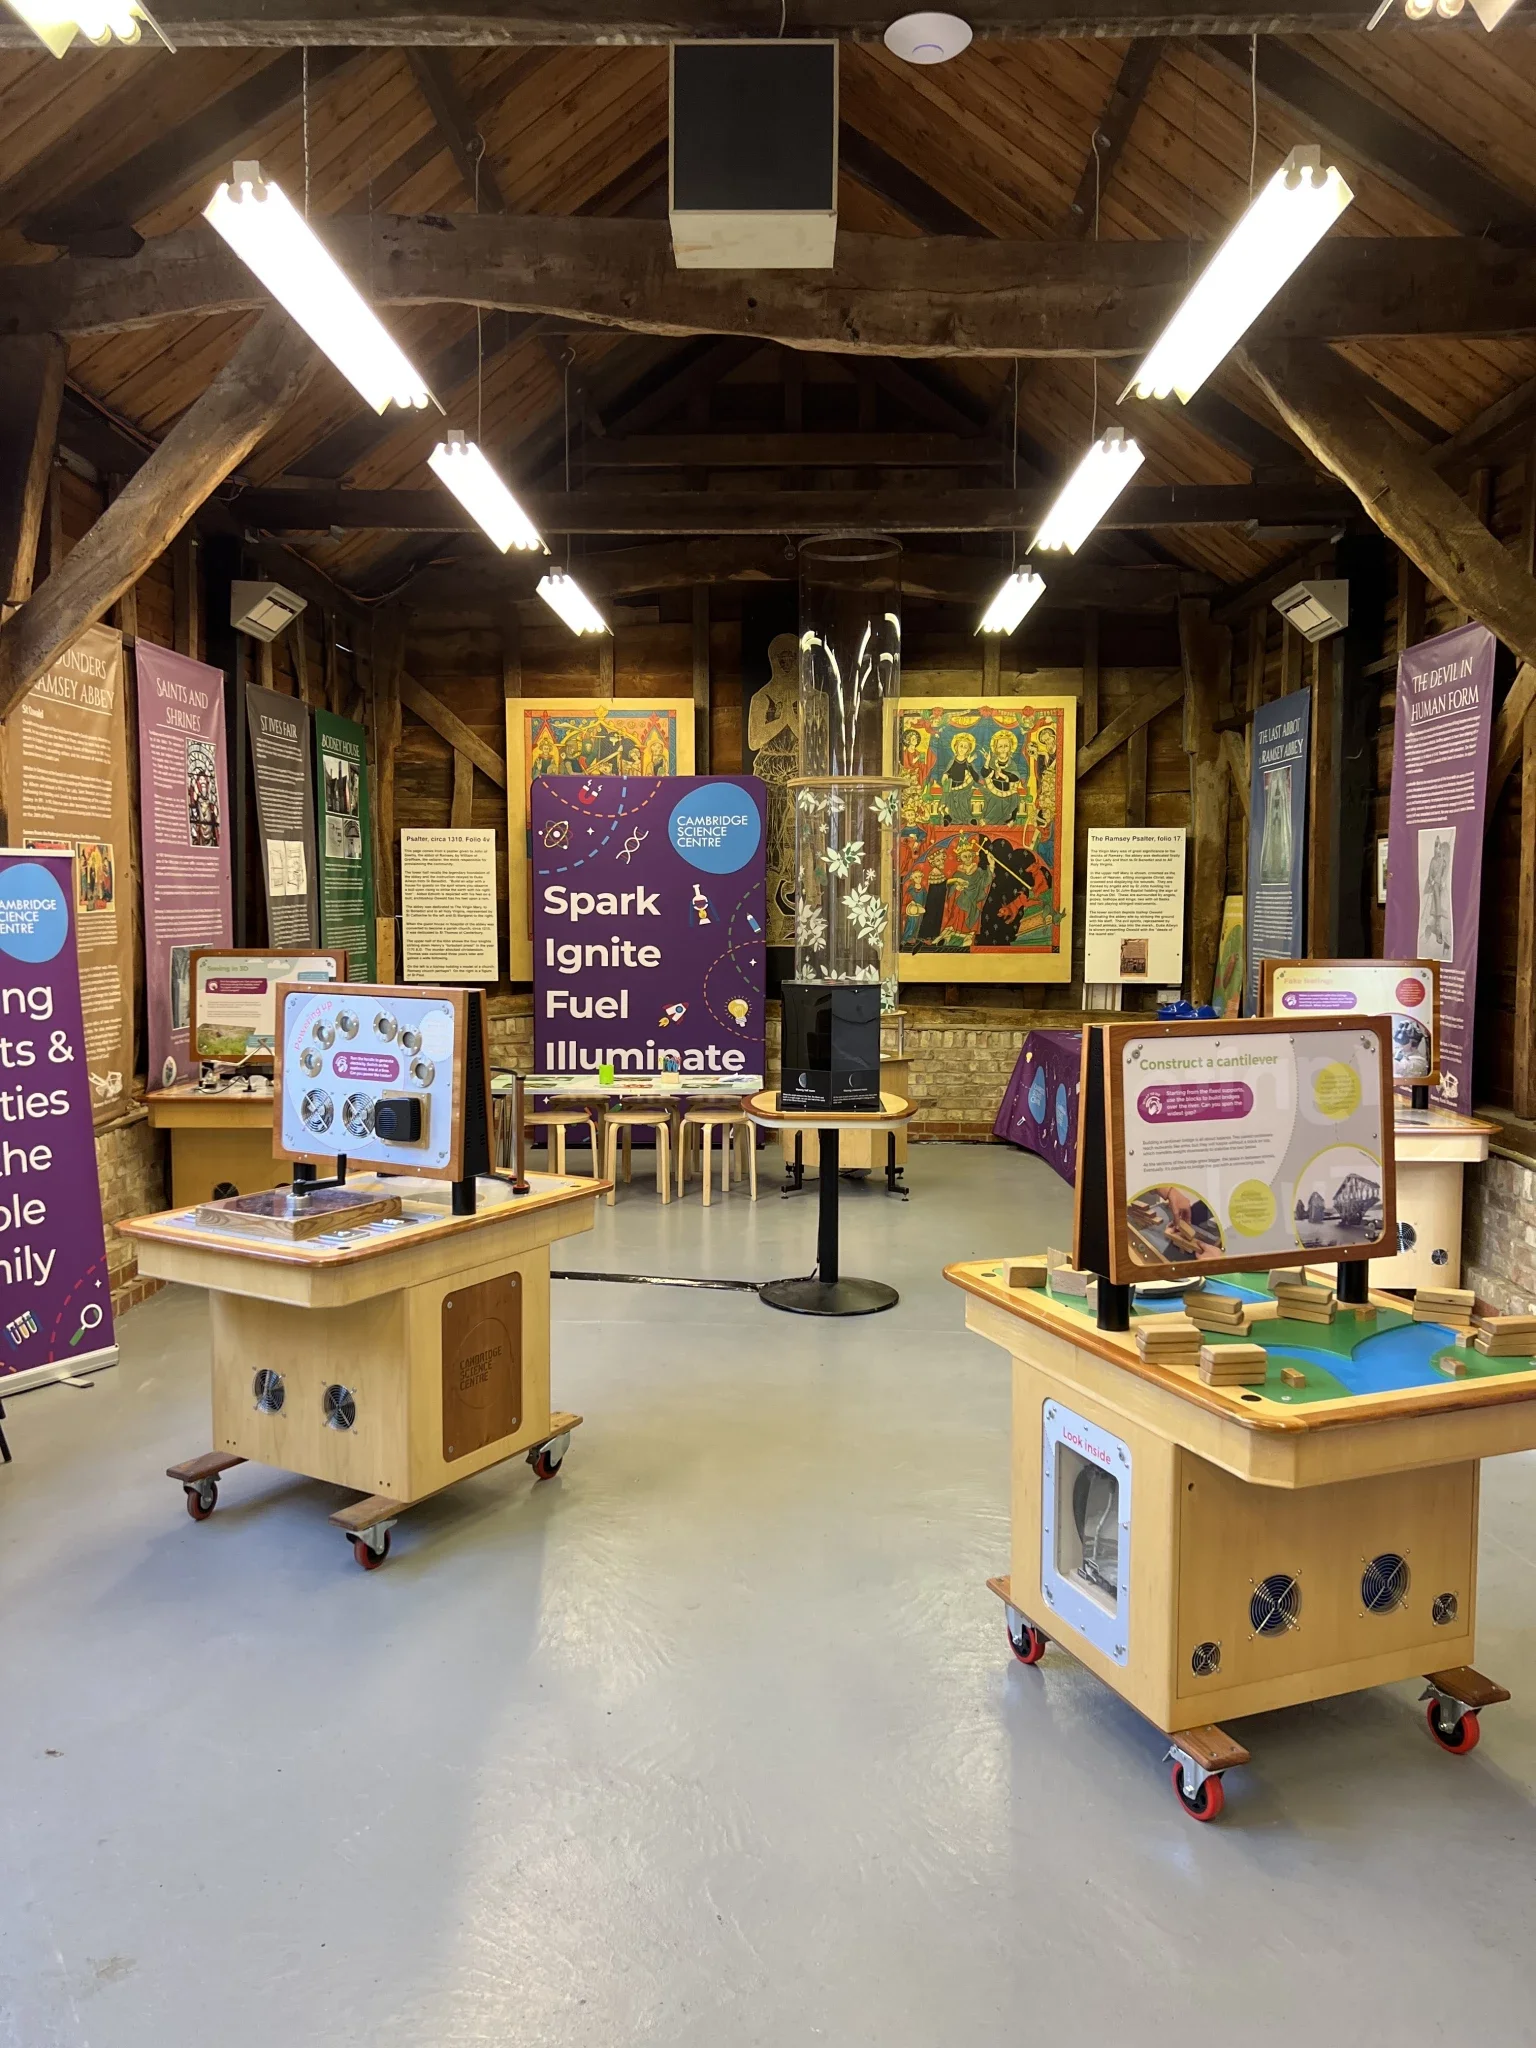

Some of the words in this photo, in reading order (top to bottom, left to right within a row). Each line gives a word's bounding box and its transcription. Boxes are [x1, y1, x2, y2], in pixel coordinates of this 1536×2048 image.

[56, 649, 106, 679] UNDERS
[1413, 674, 1427, 693] THE
[1430, 666, 1458, 689] DEVIL
[1460, 657, 1473, 678] IN
[35, 674, 78, 699] AMSEY
[80, 684, 114, 709] ABBEY
[157, 678, 186, 703] SAINTS
[189, 690, 208, 709] AND
[1411, 694, 1446, 721] HUMAN
[1448, 685, 1479, 710] FORM
[167, 707, 200, 732] SHRINES
[260, 715, 268, 731] ST
[269, 717, 282, 734] IVES
[283, 720, 298, 738] FAIR
[1259, 729, 1268, 744] THE
[1269, 724, 1282, 741] LAST
[1282, 717, 1301, 737] ABBOT
[322, 734, 342, 752] BODSEY
[343, 739, 360, 757] HOUSE
[1262, 745, 1284, 763] RAMSEY
[1284, 738, 1304, 758] ABBEY
[677, 815, 748, 826] CAMBRIDGE
[677, 827, 727, 837] SCIENCE
[677, 837, 721, 848] CENTRE
[544, 886, 661, 922] Spark
[546, 936, 661, 974] Ignite
[322, 1000, 332, 1011] up
[546, 990, 629, 1019] Fuel
[48, 1030, 74, 1063] &
[547, 1039, 746, 1071] Illuminate
[1140, 1056, 1203, 1071] Construct
[1206, 1058, 1214, 1067] a
[1216, 1054, 1278, 1067] cantilever
[0, 1141, 52, 1177] he
[460, 1346, 502, 1370] CAMBRIDGE
[460, 1360, 492, 1380] SCIENCE
[460, 1371, 488, 1391] CENTRE
[1063, 1426, 1082, 1448] Look
[1084, 1438, 1111, 1465] inside
